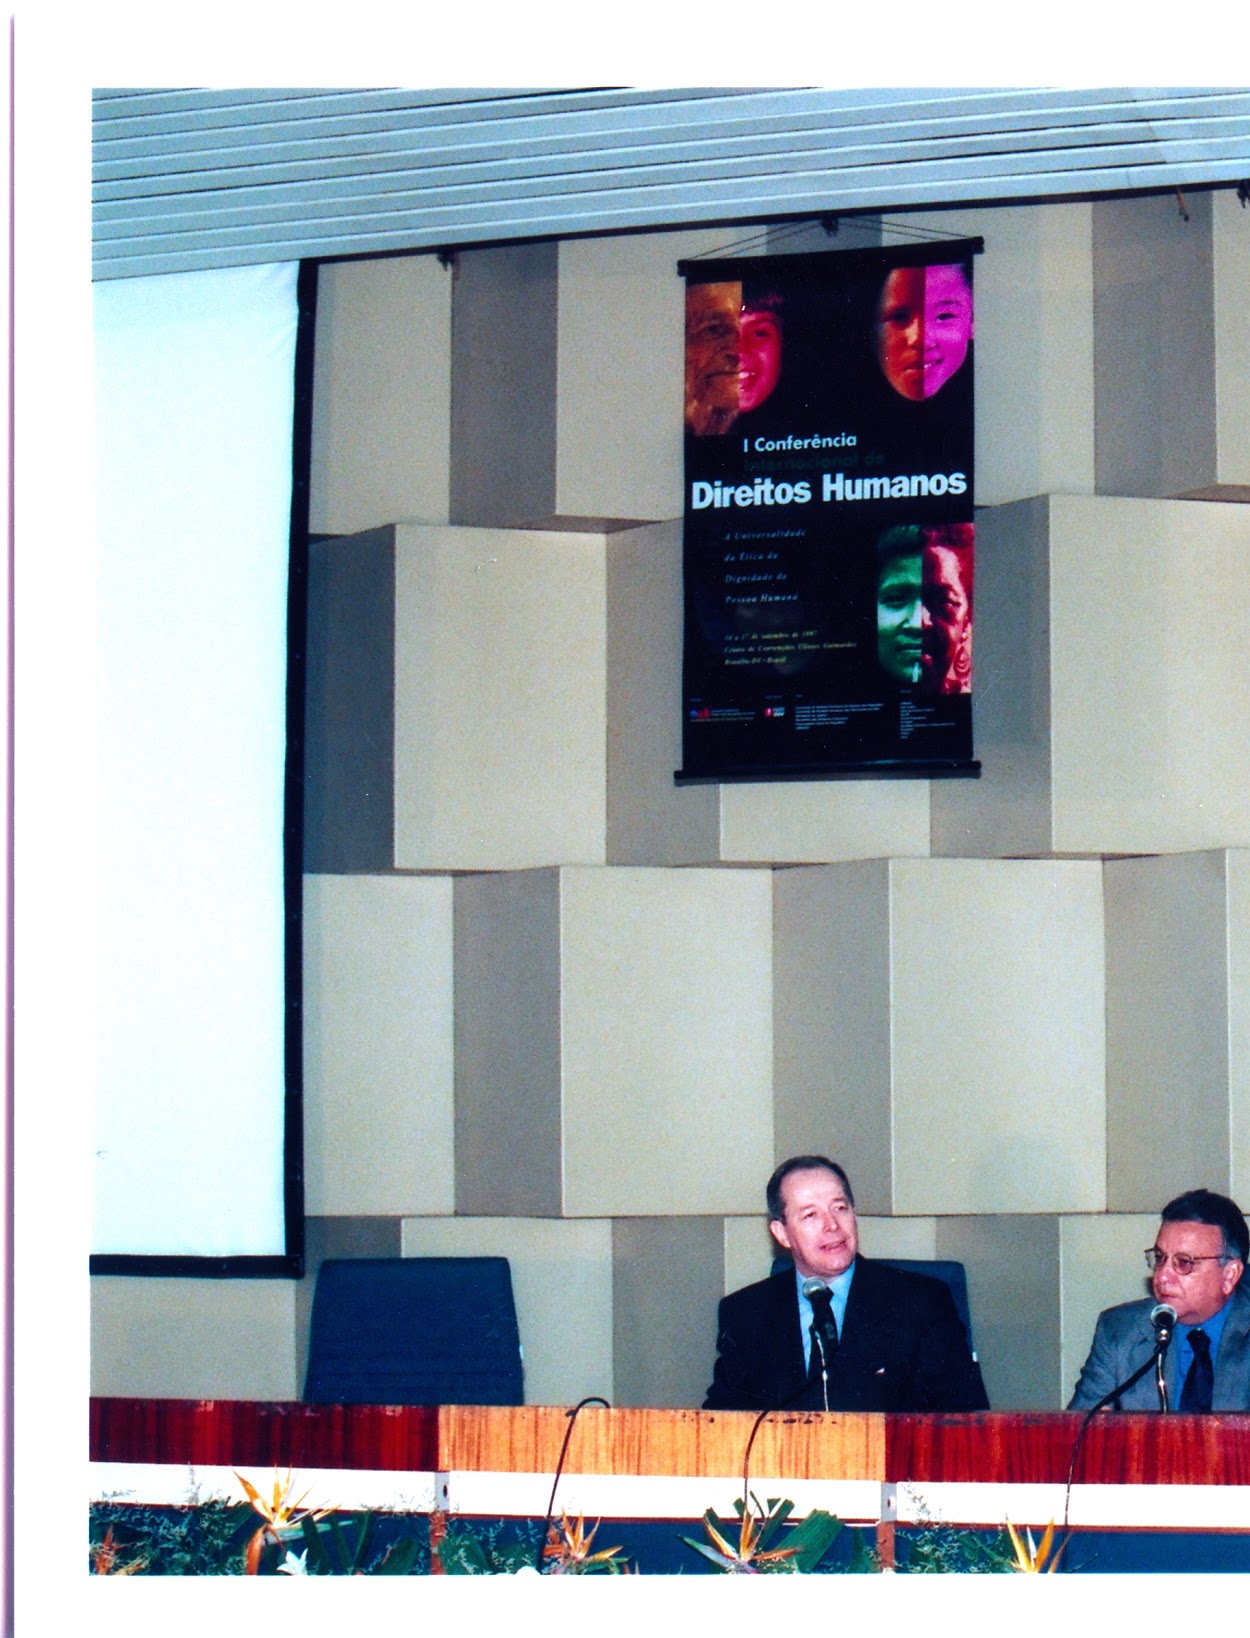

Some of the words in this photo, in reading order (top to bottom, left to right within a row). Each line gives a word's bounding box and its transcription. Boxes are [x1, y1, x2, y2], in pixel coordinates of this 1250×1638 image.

[743, 438, 749, 453] I
[754, 433, 858, 452] Conferência
[743, 453, 859, 472] Internacional
[863, 453, 886, 467] de
[692, 477, 812, 509] Direitos
[822, 472, 968, 502] Humanos
[734, 529, 807, 540] Universalidade
[725, 571, 773, 584] Dignidade
[725, 595, 757, 605] Pessoa
[760, 592, 799, 602] Humana
